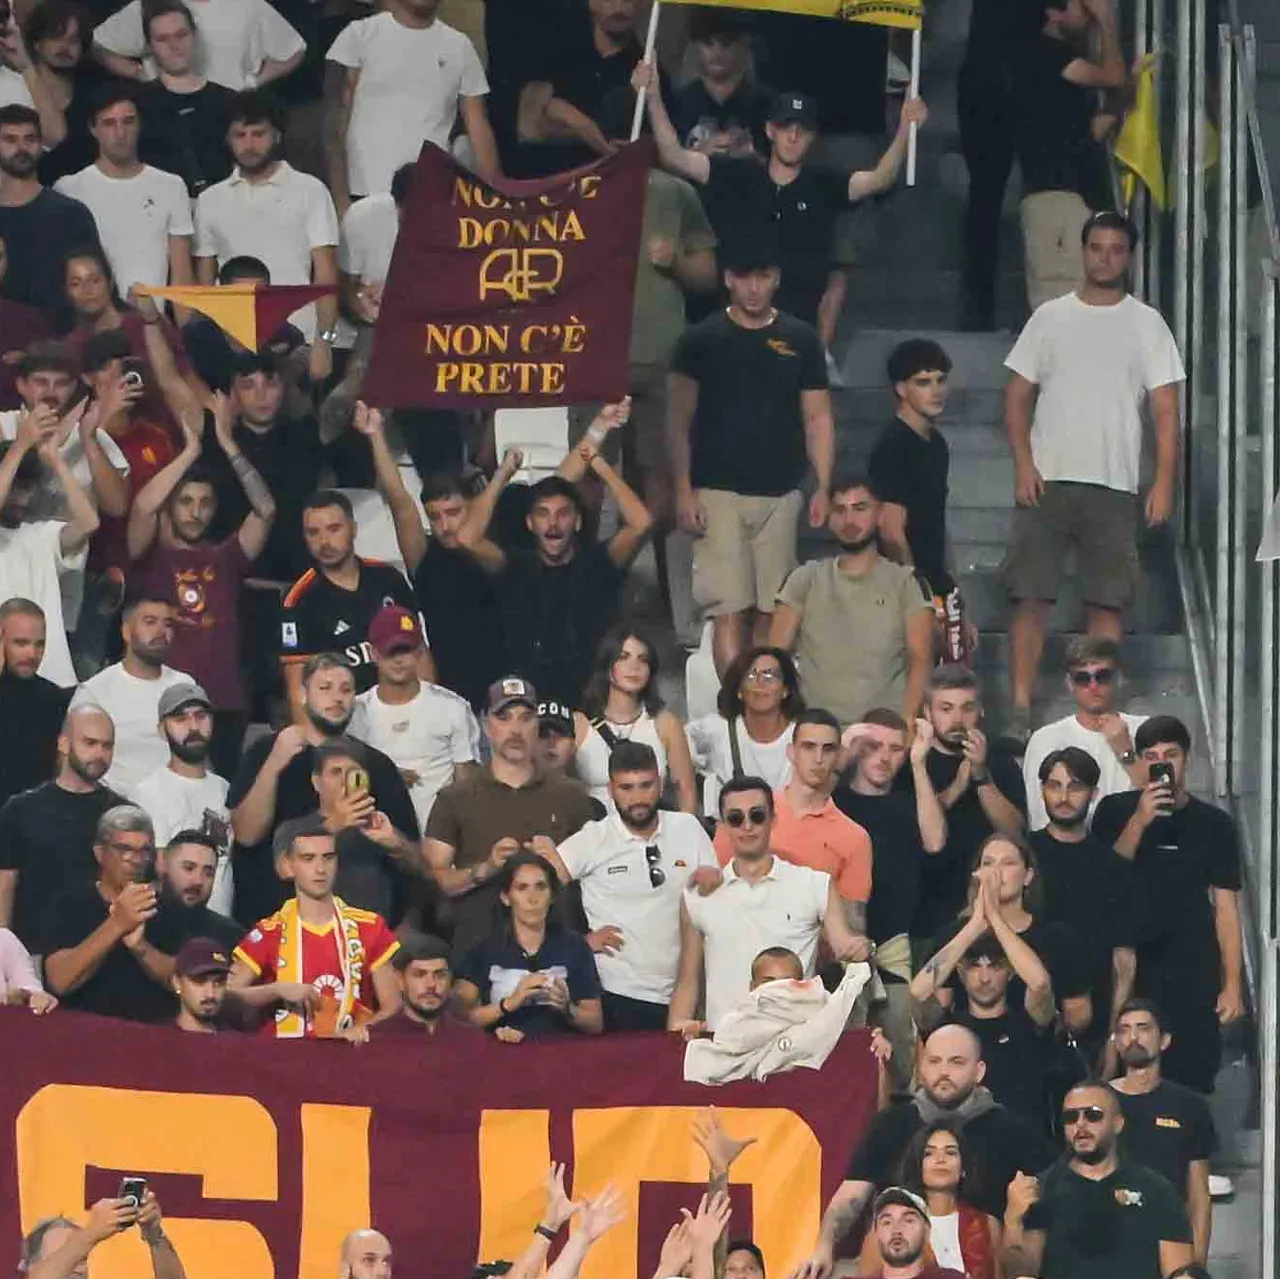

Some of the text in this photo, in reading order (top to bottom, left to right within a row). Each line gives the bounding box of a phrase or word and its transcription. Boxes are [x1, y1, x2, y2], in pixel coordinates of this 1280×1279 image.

[458, 208, 587, 249] DONNA
[424, 322, 510, 355] NON
[433, 361, 566, 394] PRETE
